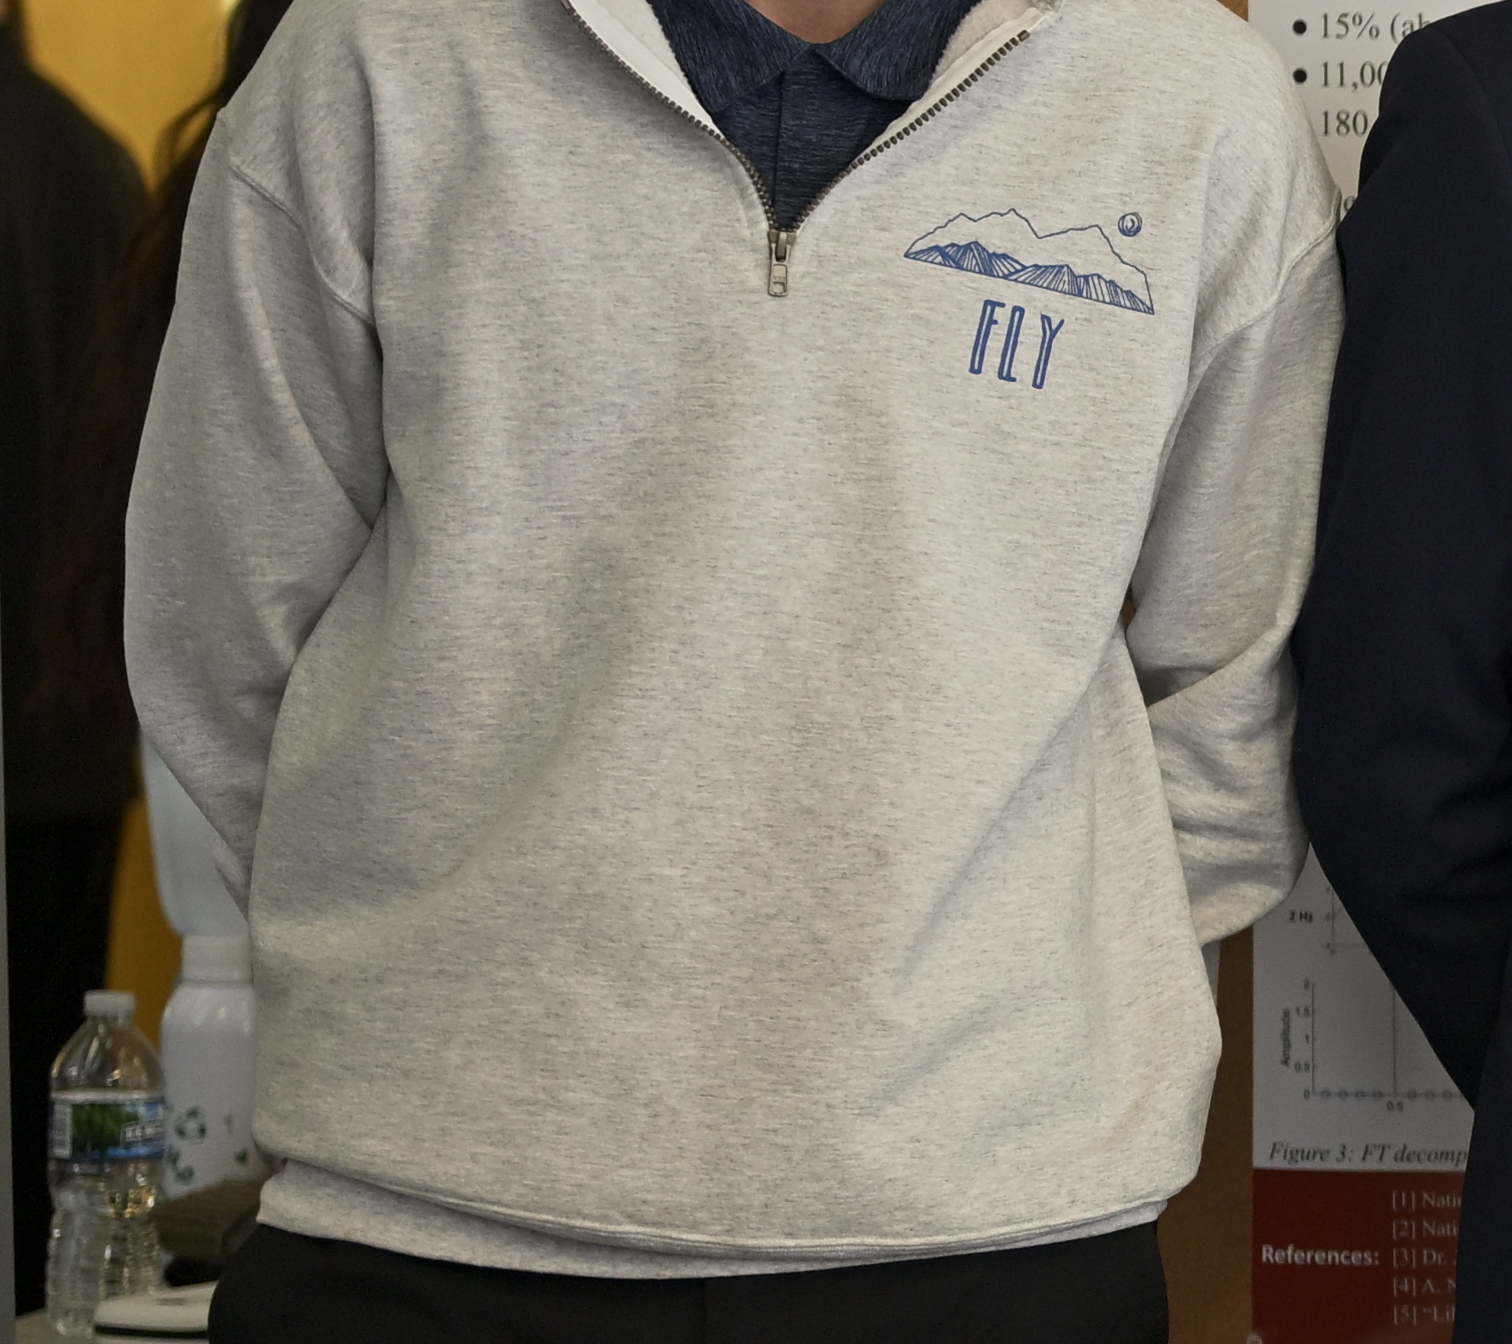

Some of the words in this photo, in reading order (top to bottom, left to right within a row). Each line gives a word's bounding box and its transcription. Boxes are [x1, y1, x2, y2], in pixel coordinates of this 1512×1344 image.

[1322, 12, 1381, 40] 15%
[1322, 110, 1372, 140] 180
[968, 299, 1065, 390] FLY
[1269, 1142, 1330, 1165] Figure
[1336, 1143, 1353, 1163] 3:
[1361, 1144, 1390, 1163] FT
[1393, 1190, 1415, 1211] [1]
[1393, 1219, 1415, 1240] [2]
[1261, 1244, 1380, 1266] References:
[1393, 1248, 1416, 1269] [3]
[1393, 1277, 1416, 1298] [4]
